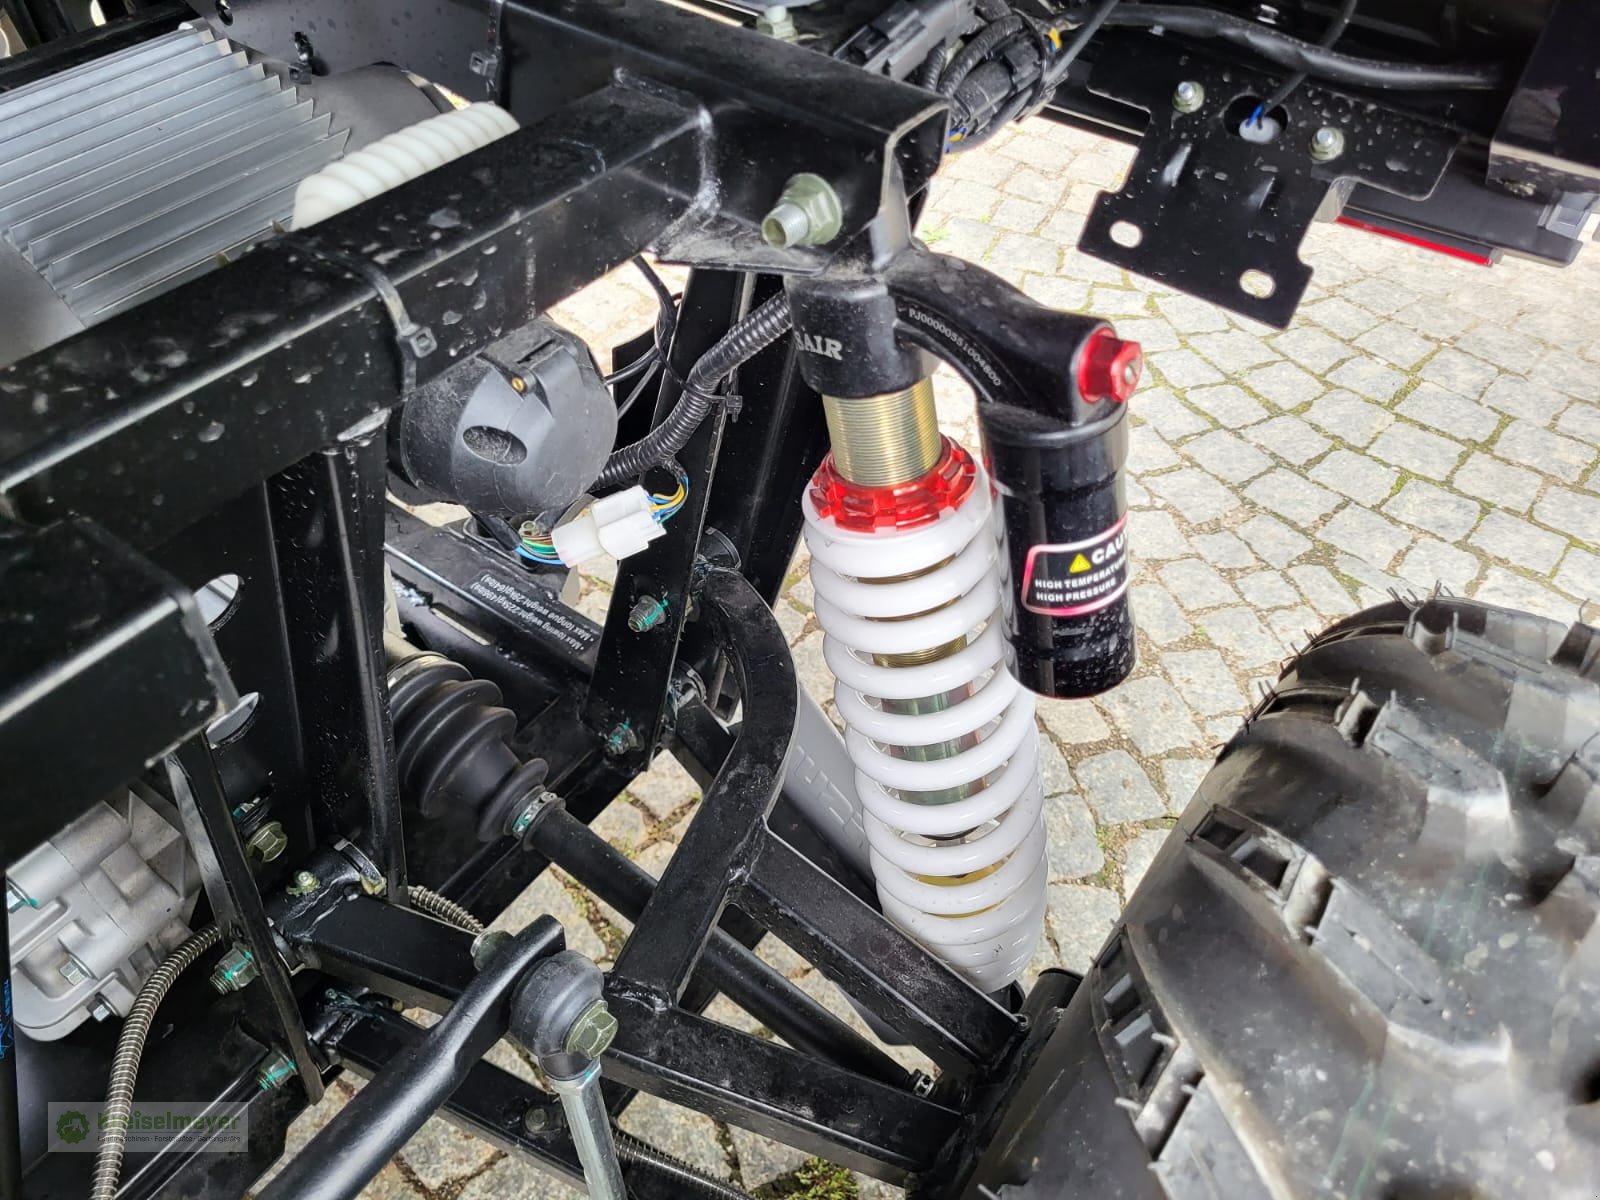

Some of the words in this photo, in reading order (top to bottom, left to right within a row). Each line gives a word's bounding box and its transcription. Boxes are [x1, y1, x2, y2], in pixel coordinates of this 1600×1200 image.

[1035, 578, 1063, 590] HIGH
[1036, 592, 1064, 602] HIGH
[1065, 576, 1117, 602] PRESSURE
[548, 612, 575, 633] tongue
[573, 626, 591, 641] Max
[564, 637, 581, 649] Max
